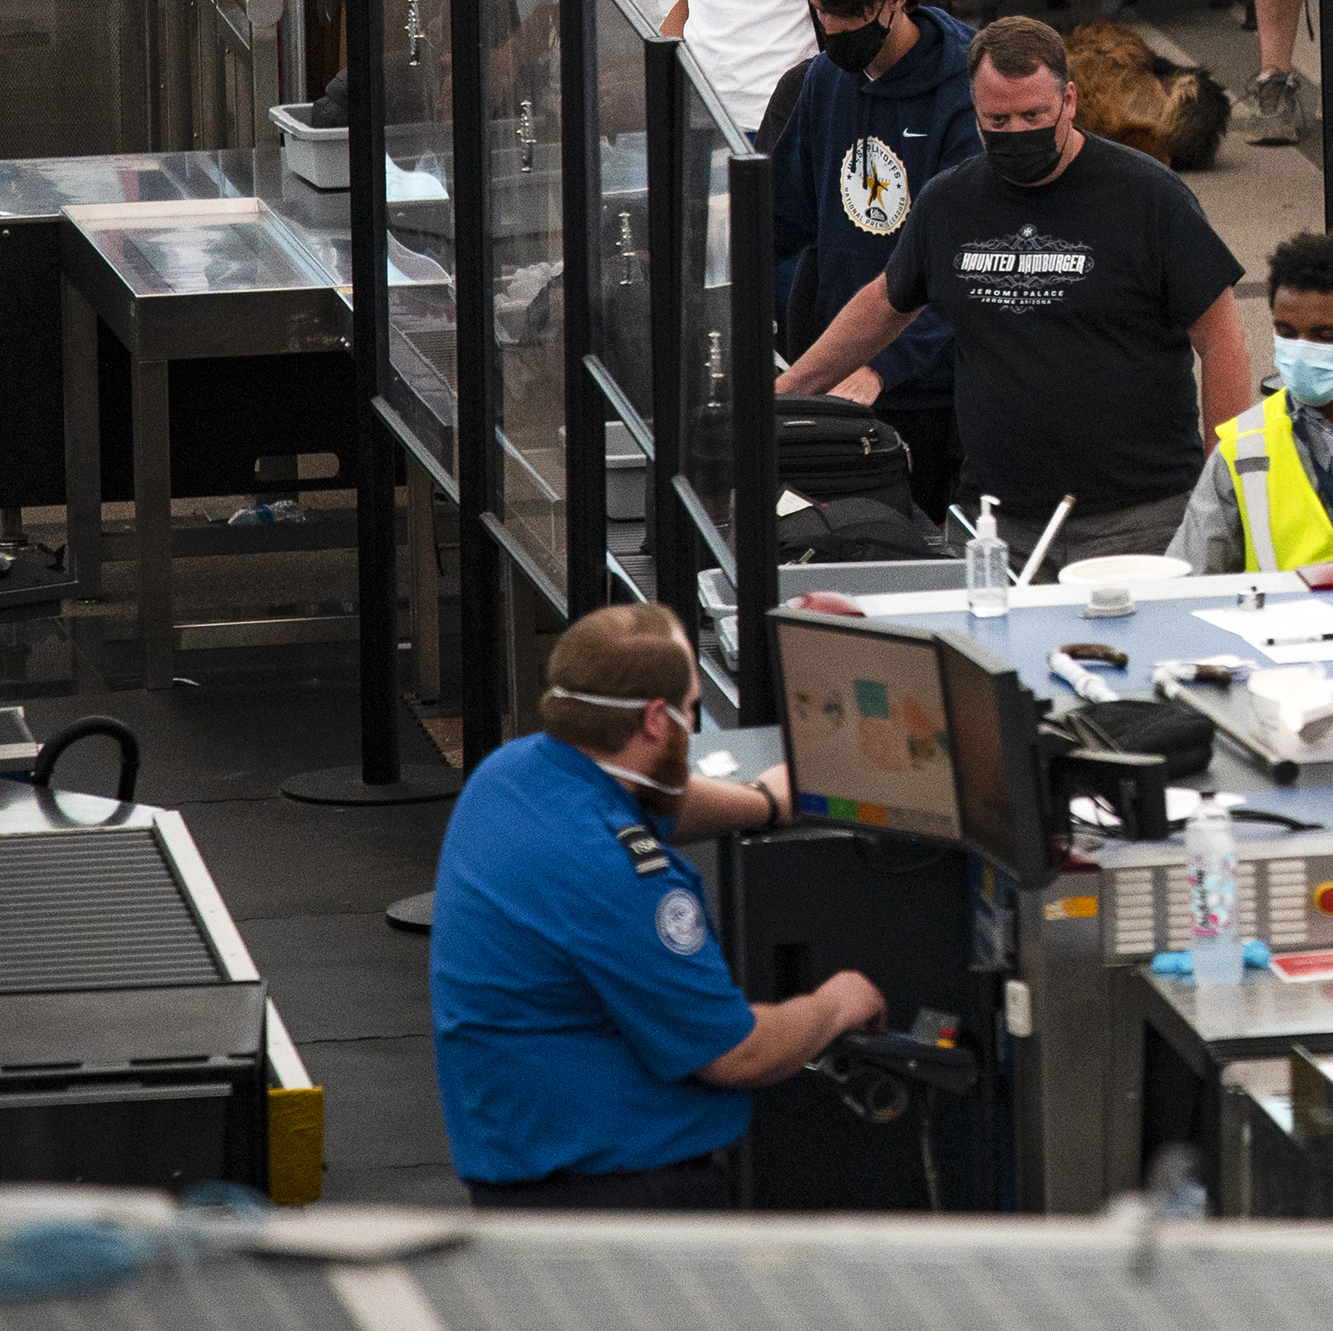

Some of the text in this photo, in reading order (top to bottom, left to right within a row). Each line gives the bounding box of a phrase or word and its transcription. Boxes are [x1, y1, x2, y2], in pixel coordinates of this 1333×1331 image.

[844, 186, 864, 222] NATIONAL
[961, 253, 1086, 275] HAUNTED HAMBURGER
[970, 288, 1018, 297] JEROME
